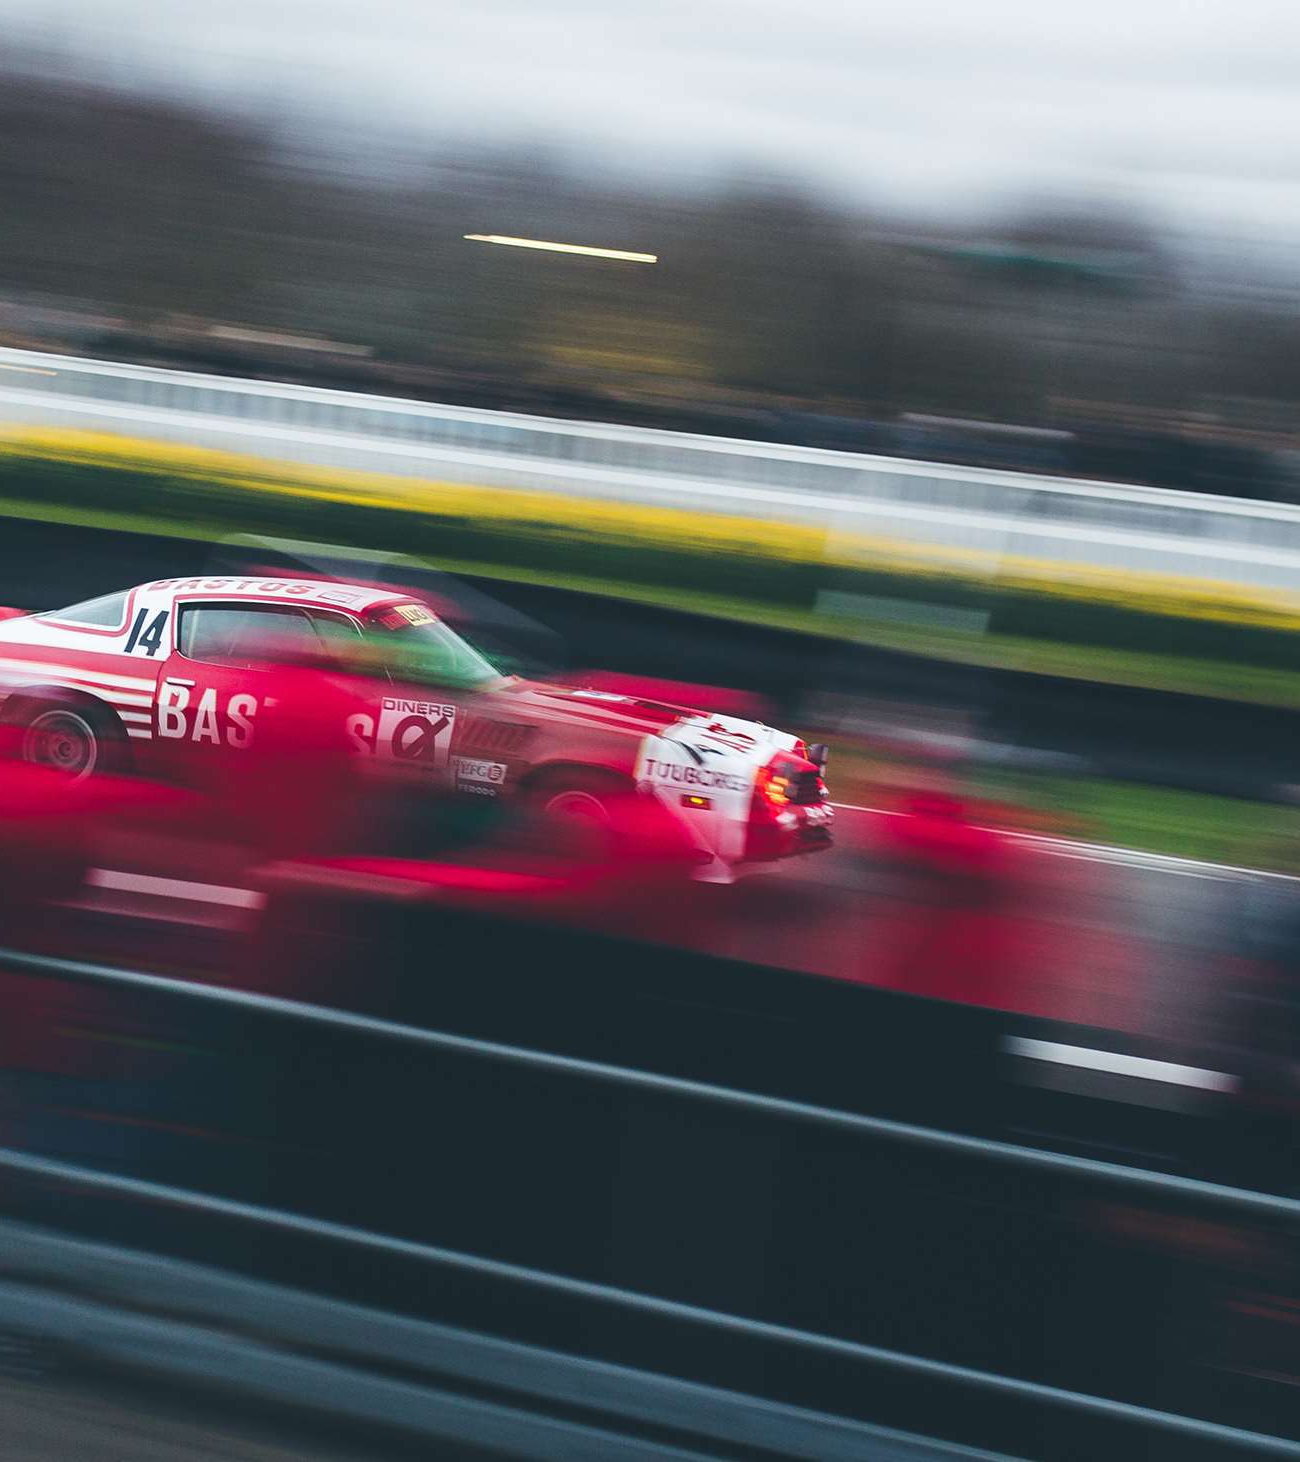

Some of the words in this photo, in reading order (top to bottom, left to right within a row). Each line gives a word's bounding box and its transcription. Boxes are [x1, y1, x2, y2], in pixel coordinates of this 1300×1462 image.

[124, 607, 170, 656] 14
[158, 680, 376, 756] BASS
[383, 699, 454, 718] DINERS
